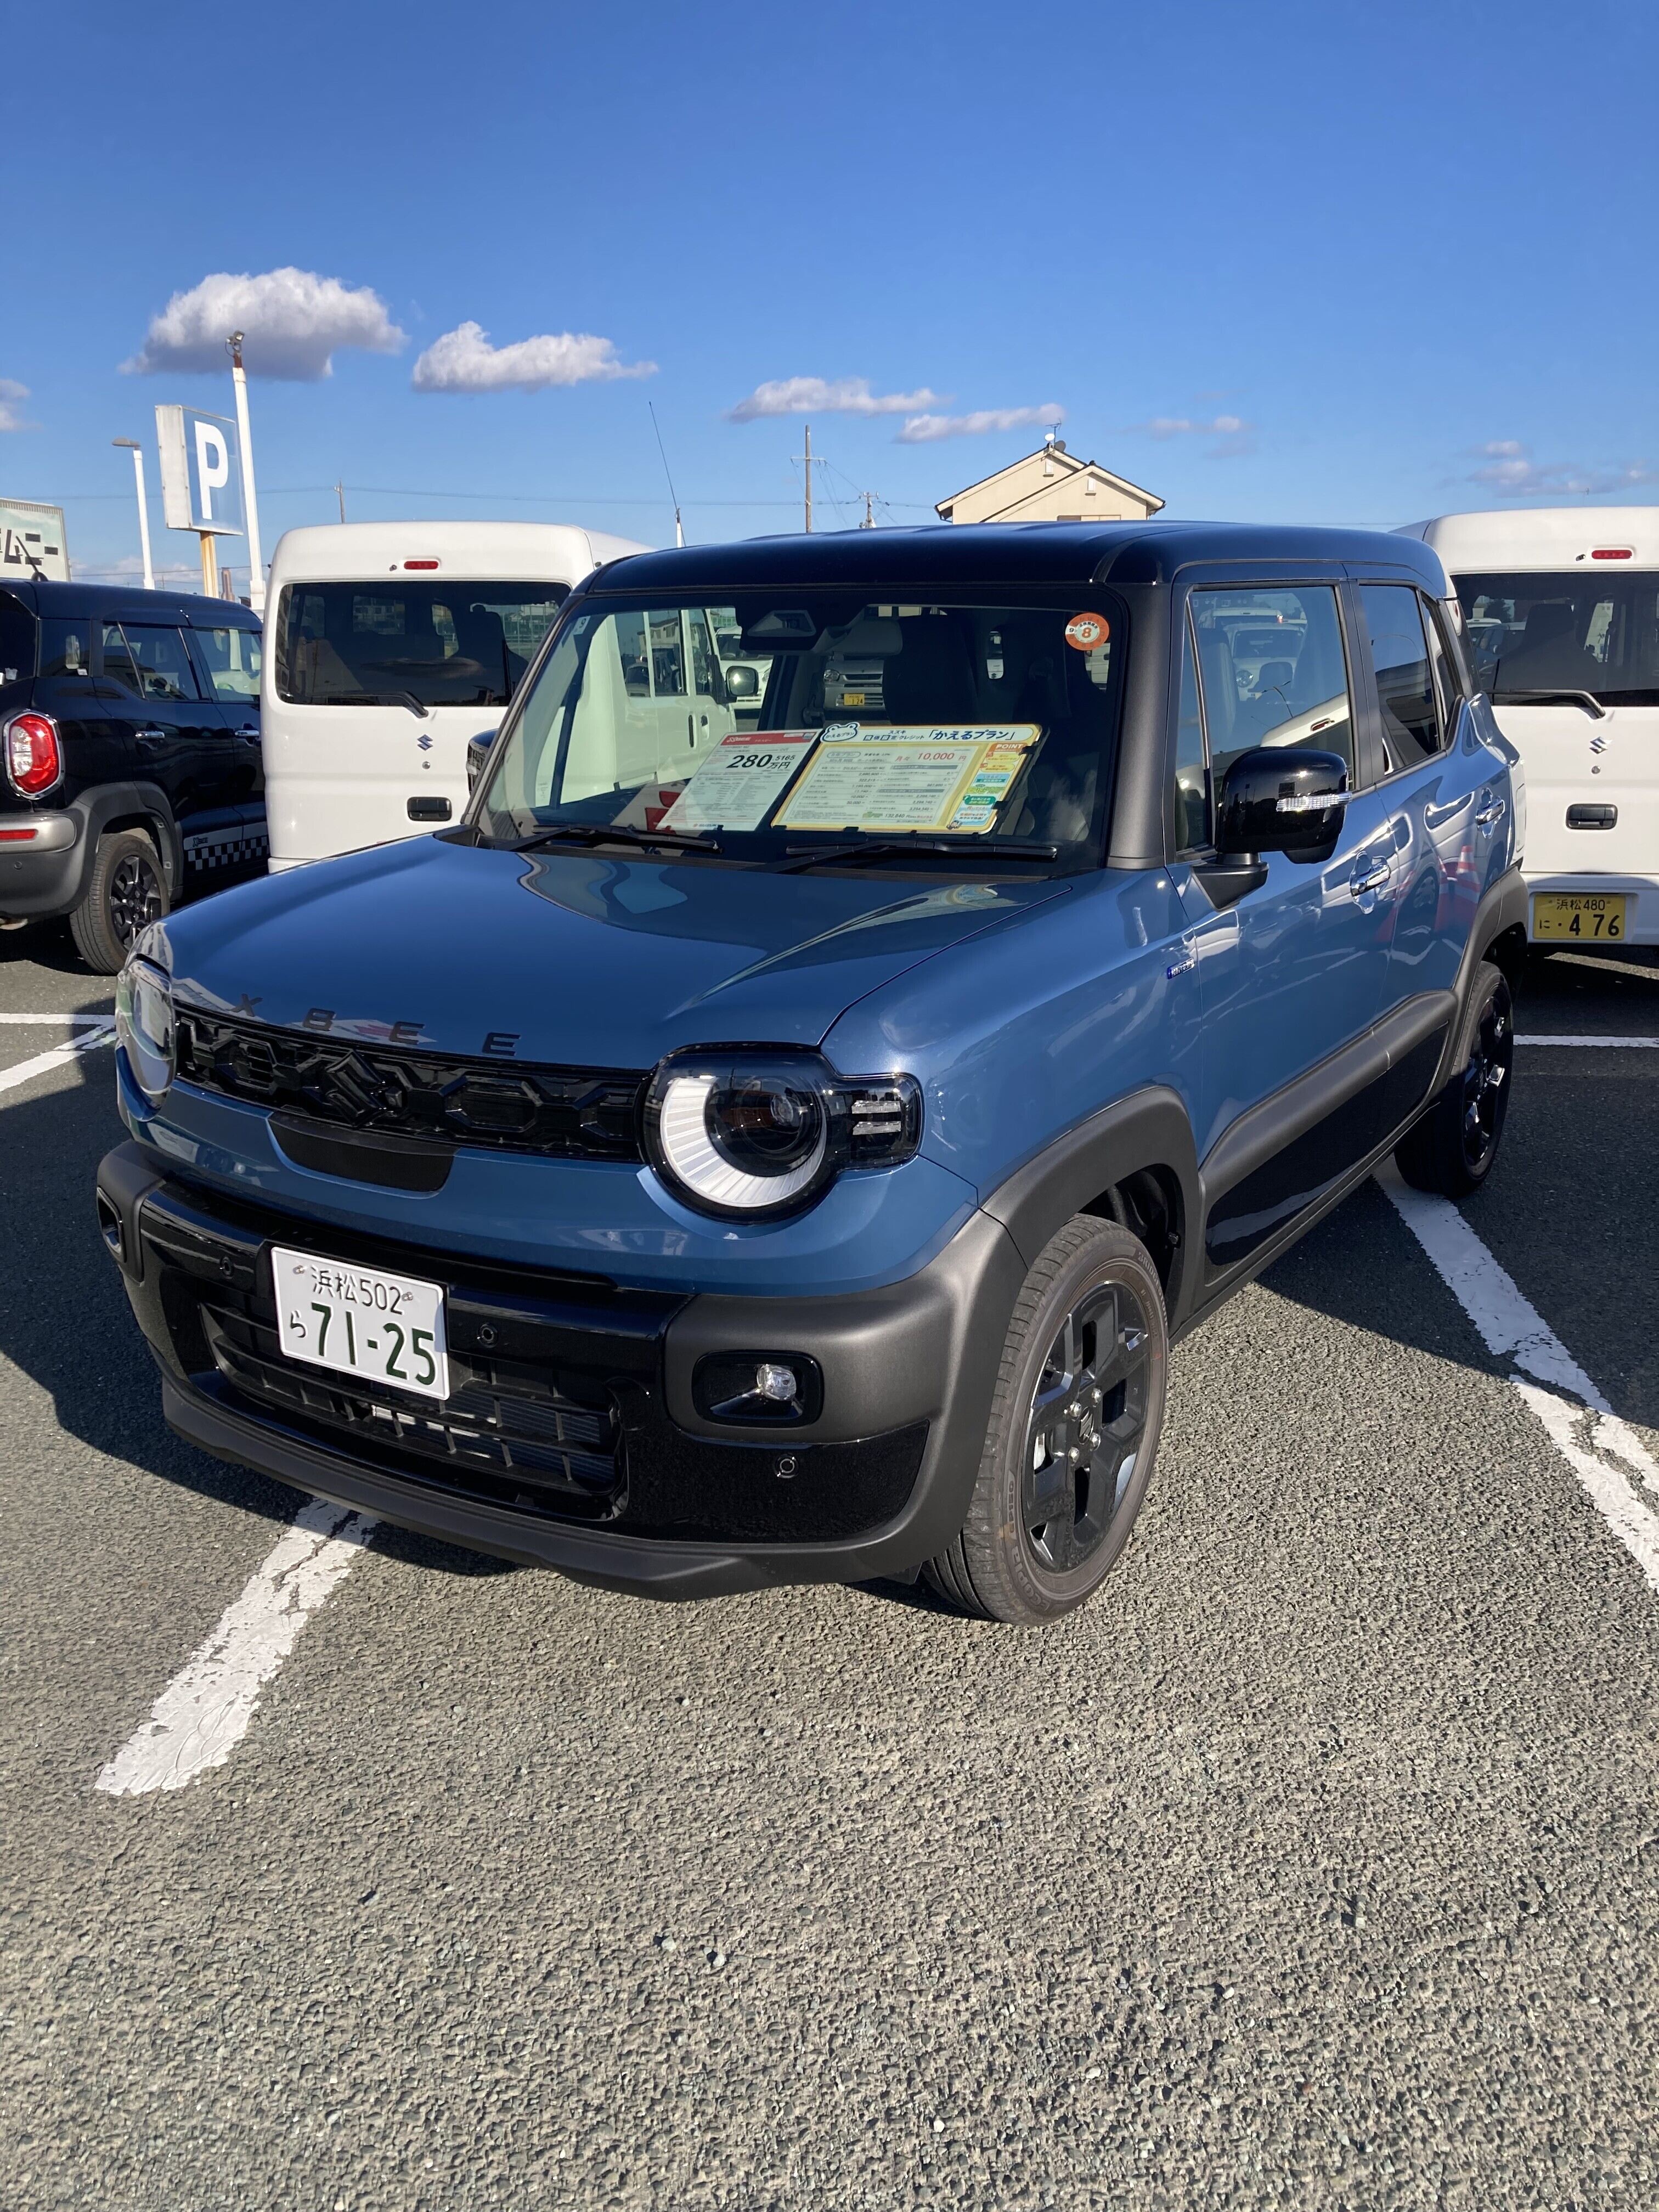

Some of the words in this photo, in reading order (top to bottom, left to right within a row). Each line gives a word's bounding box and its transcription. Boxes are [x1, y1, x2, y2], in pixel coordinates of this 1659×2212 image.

[194, 420, 229, 520] P
[0, 528, 58, 566] ムニー
[1081, 627, 1092, 638] 8
[929, 729, 1015, 741] 「かえるプラン」
[726, 754, 773, 769] 280
[917, 752, 955, 761] 10,000
[1556, 898, 1606, 911] 浜松480
[1539, 919, 1550, 929] に
[311, 1265, 404, 1316] 浜松502
[289, 1310, 308, 1339] ら
[310, 1302, 437, 1386] 71-25
